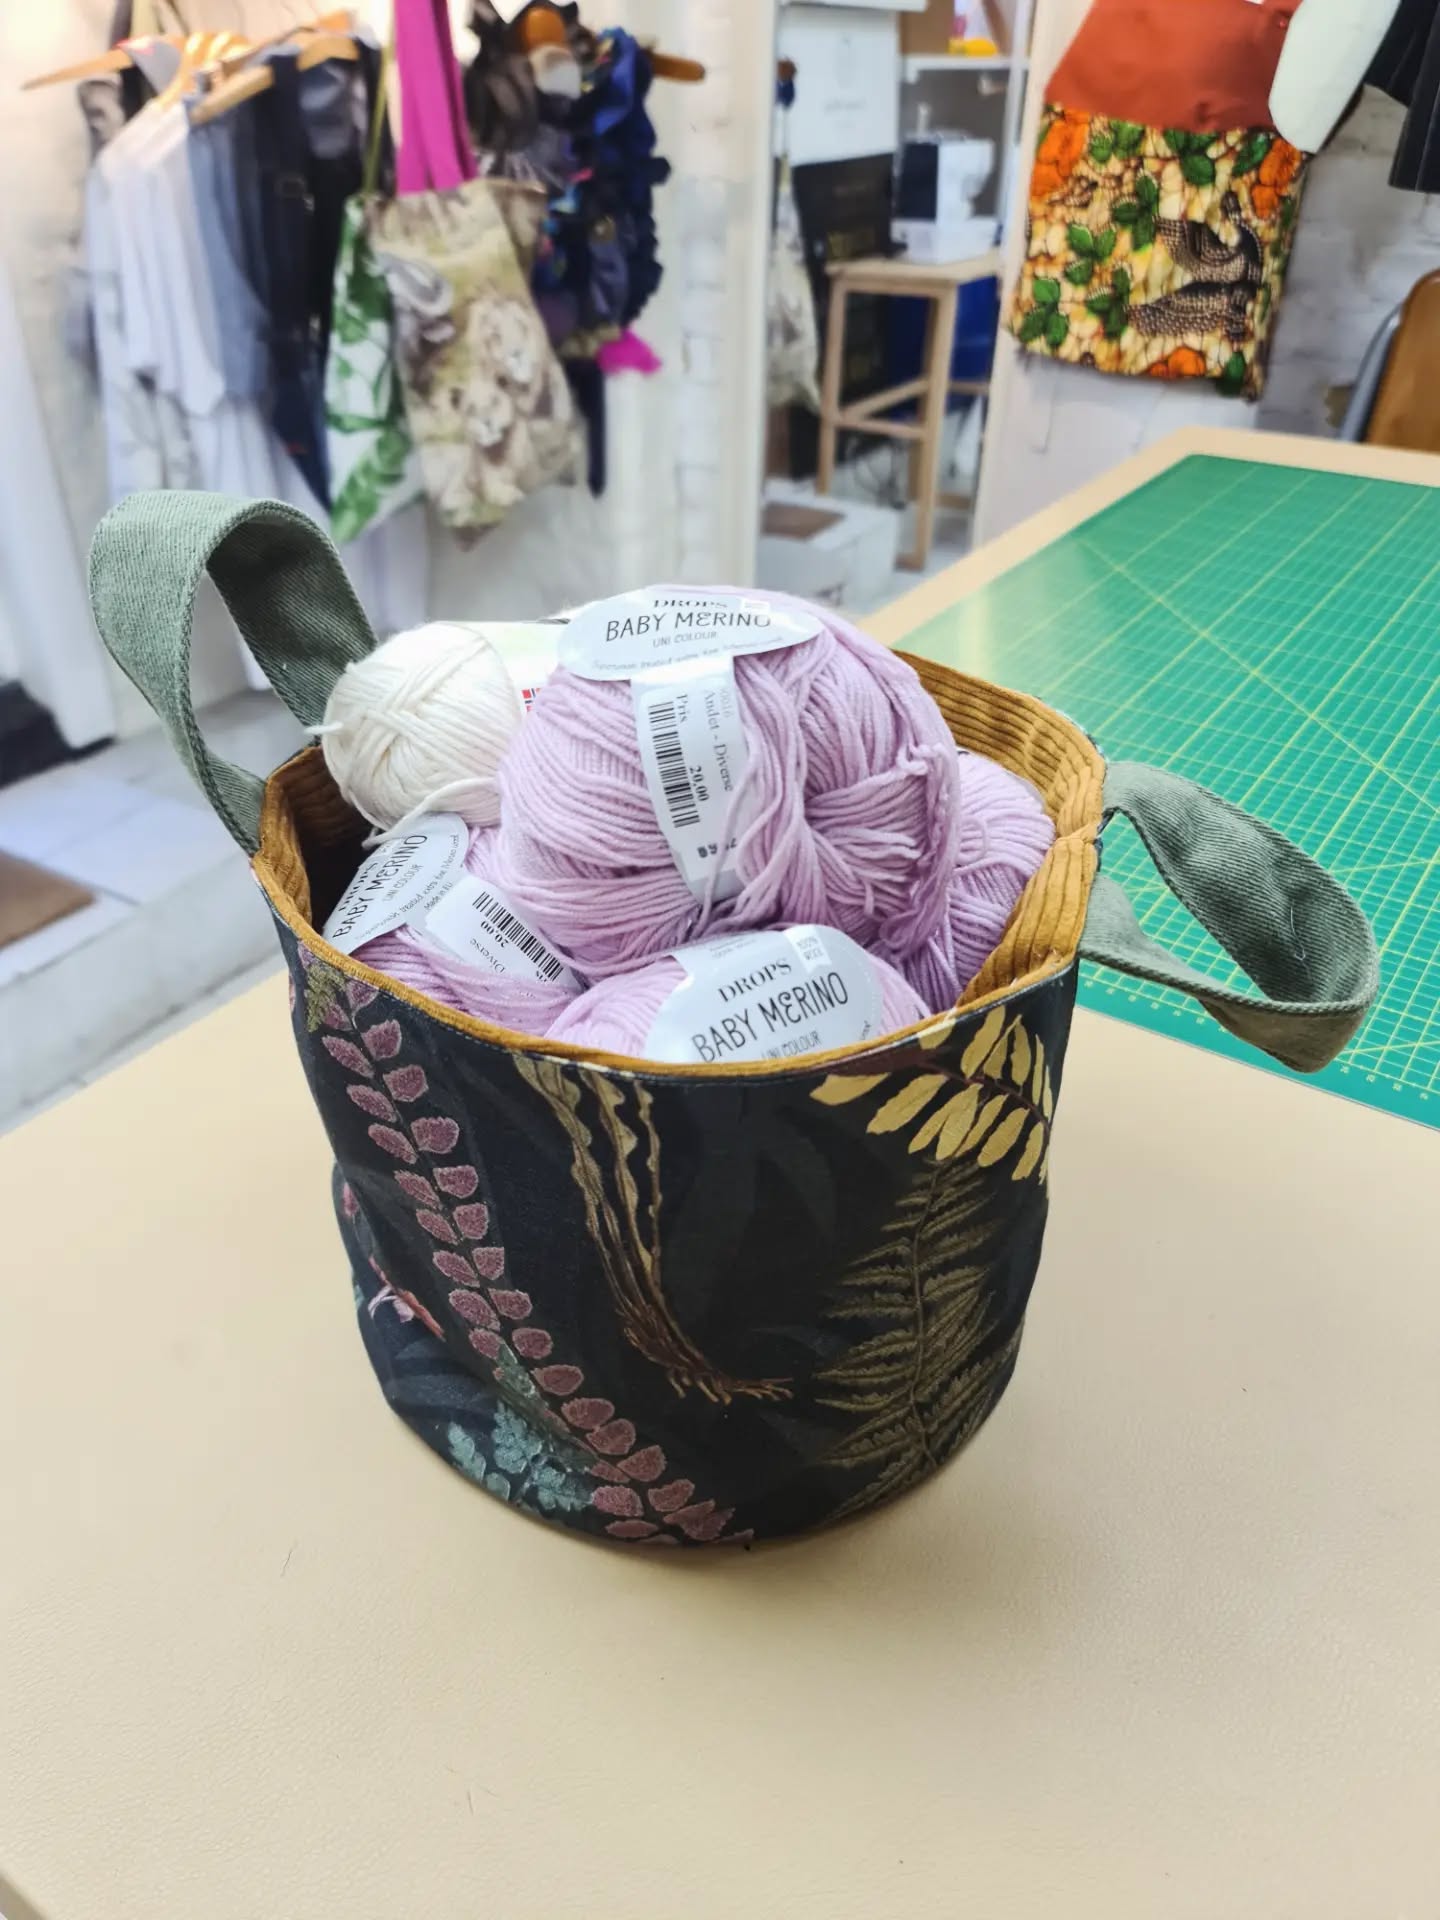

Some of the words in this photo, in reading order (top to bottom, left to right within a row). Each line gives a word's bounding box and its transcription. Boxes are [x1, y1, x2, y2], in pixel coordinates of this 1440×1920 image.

[605, 611, 668, 642] BABY
[674, 610, 772, 629] MERINO
[653, 637, 671, 649] UNI
[673, 631, 717, 644] COLOUR
[674, 693, 689, 722] Pris
[704, 690, 720, 730] Andet
[714, 743, 733, 792] Diverse
[332, 896, 374, 938] BABY
[366, 834, 428, 891] MERINO
[469, 937, 506, 975] Diverse
[716, 957, 792, 1003] DROPS
[691, 1011, 758, 1063] BABY
[758, 971, 849, 1034] MERINO
[780, 1030, 822, 1057] COLOUR
